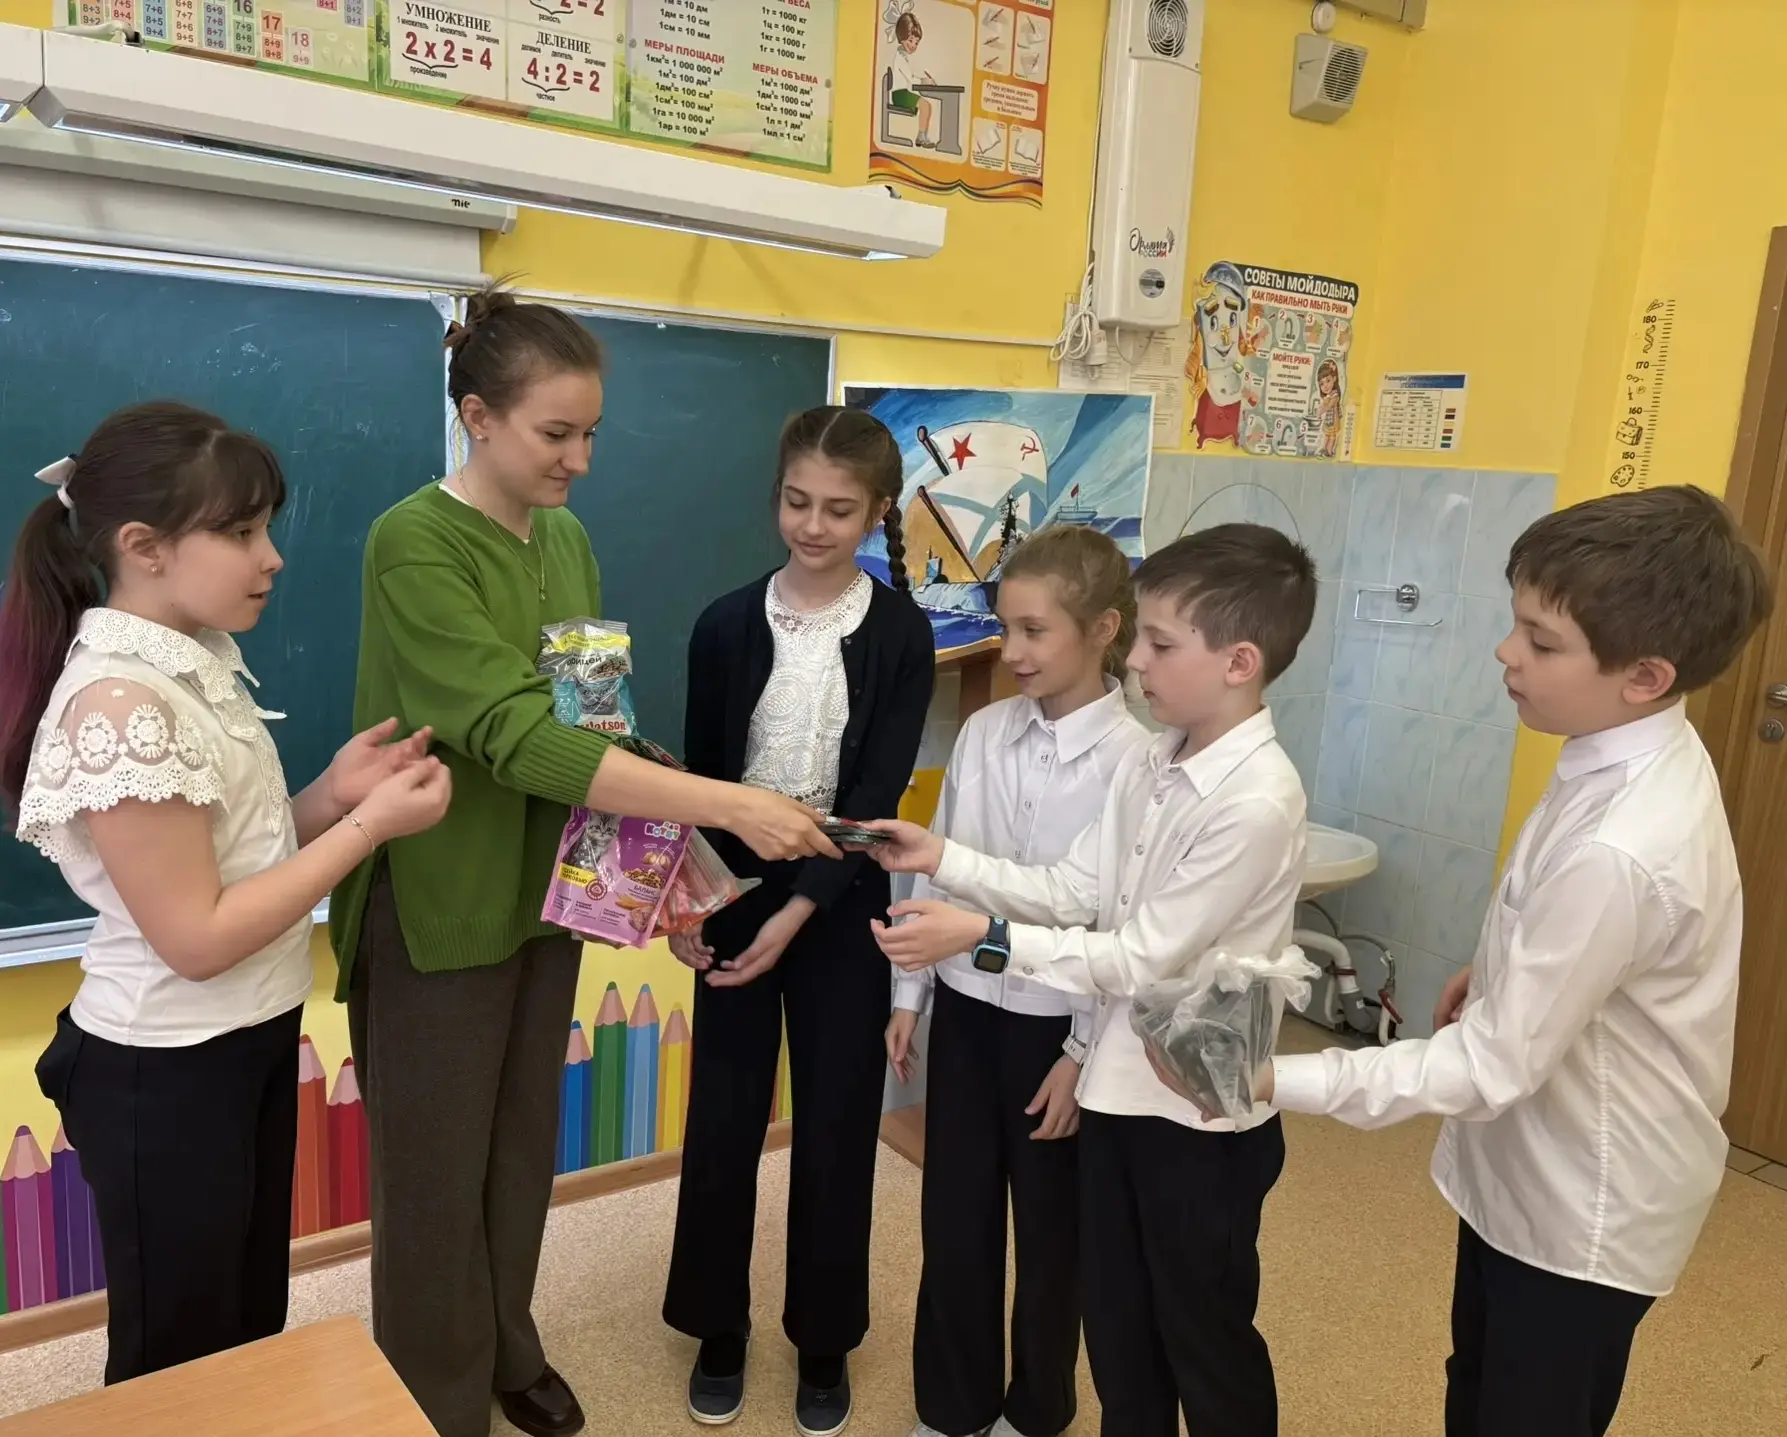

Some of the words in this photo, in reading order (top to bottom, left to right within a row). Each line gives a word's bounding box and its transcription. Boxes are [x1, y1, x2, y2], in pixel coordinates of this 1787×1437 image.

[83, 4, 101, 14] 8+3
[146, 4, 163, 14] 7+6
[206, 4, 224, 14] 6+9
[234, 0, 253, 14] 16
[685, 1, 694, 10] 10
[696, 5, 708, 13] дм
[114, 10, 131, 20] 8+4
[176, 10, 193, 20] 7+7
[405, 2, 492, 32] УМНОЖЕНИЕ
[660, 8, 676, 18] 1дм
[687, 15, 697, 24] 10
[779, 11, 797, 22] 1000
[799, 16, 807, 24] кг
[146, 16, 163, 26] 8+5
[207, 15, 224, 26] 7+8
[263, 15, 281, 31] 17
[176, 22, 194, 31] 8+6
[236, 21, 252, 32] 7+9
[659, 21, 675, 31] 1см
[686, 28, 695, 37] 10
[698, 31, 710, 40] мм
[781, 24, 795, 34] 100
[797, 28, 805, 36] кг
[146, 27, 163, 38] 9+4
[207, 27, 224, 37] 8+7
[177, 33, 194, 43] 9+5
[207, 38, 224, 48] 9+6
[236, 33, 252, 43] 8+8
[292, 31, 309, 48] 18
[536, 31, 592, 54] ДЕЛЕНИЕ
[761, 32, 773, 42] 1кг
[782, 37, 800, 48] 1000
[236, 44, 252, 53] 9+7
[264, 39, 281, 48] 8+9
[264, 50, 282, 60] 9+8
[406, 31, 418, 55] 2
[444, 39, 456, 63] 2
[462, 48, 473, 62] =
[480, 48, 492, 70] 4
[645, 39, 673, 52] МЕРЫ
[676, 46, 725, 64] ПЛОЩАДИ
[777, 48, 795, 59] 1000
[293, 55, 309, 65] 9+9
[680, 60, 694, 70] 000
[697, 64, 711, 75] 000
[527, 57, 539, 80] 4
[556, 63, 567, 85] 2
[573, 71, 583, 84] =
[589, 70, 600, 92] 2
[679, 74, 694, 83] 100
[752, 63, 779, 76] МЕРЫ
[781, 69, 818, 84] ОБЪЕМА
[682, 87, 696, 97] 100
[780, 82, 798, 93] 1000
[681, 100, 695, 110] 100
[781, 95, 799, 105] 1000
[653, 107, 666, 117] 1га
[676, 112, 686, 121] 10
[688, 114, 703, 124] 000
[780, 107, 797, 117] 1000
[683, 126, 697, 135] 100
[763, 128, 778, 138] 1мл
[1244, 267, 1285, 289] СОВЕТЫ
[1287, 274, 1356, 301] МОЙДОДЫРА
[1252, 290, 1265, 301] КАК
[1266, 293, 1308, 308] ПРАВИЛЬНО
[1310, 300, 1331, 312] МЫТЬ
[1332, 303, 1348, 315] РУКИ
[1279, 310, 1286, 320] 2
[1307, 314, 1314, 324] 3
[1643, 315, 1657, 324] 180
[1272, 352, 1294, 364] МОЙТЕ
[1636, 361, 1650, 370] 170
[1244, 372, 1250, 382] 8
[1629, 407, 1643, 415] 160
[1276, 420, 1282, 429] 6
[1622, 452, 1636, 460] 150
